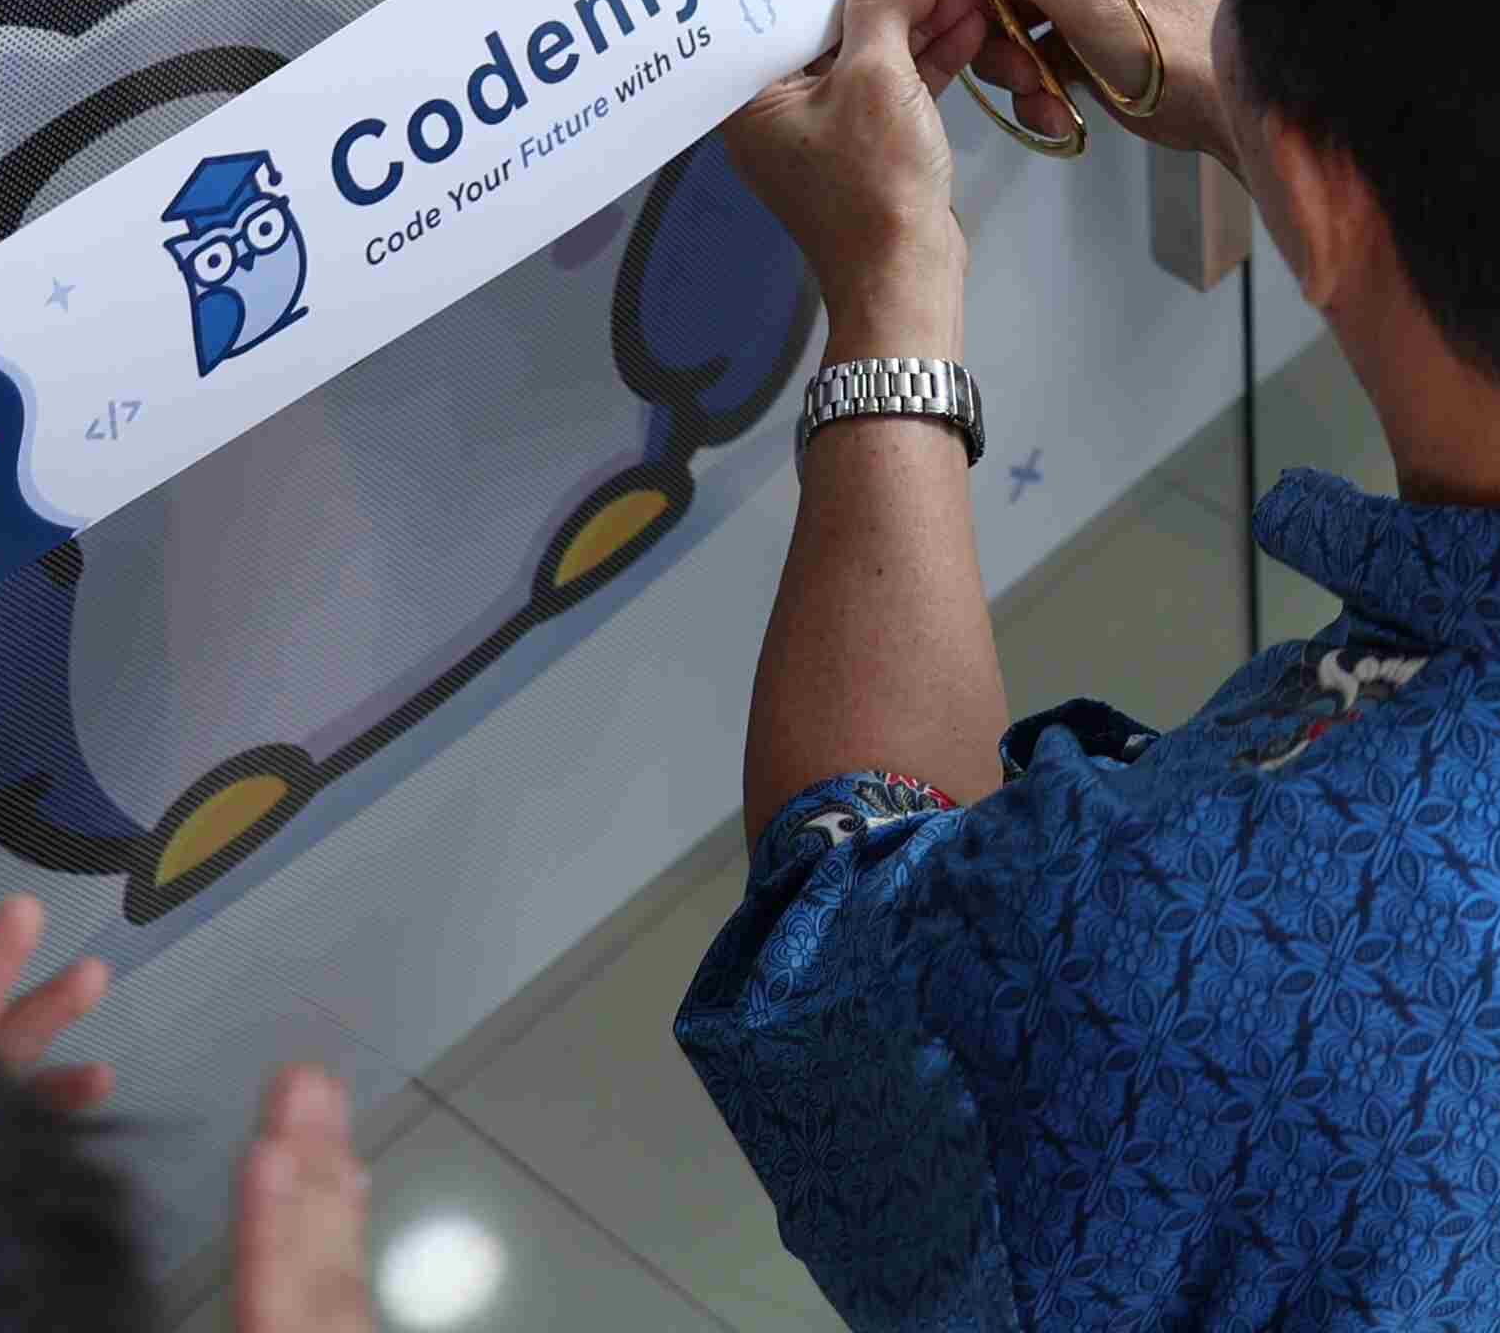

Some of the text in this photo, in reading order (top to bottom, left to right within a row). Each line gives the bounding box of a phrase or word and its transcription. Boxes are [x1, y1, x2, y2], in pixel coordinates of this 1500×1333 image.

[365, 24, 713, 266] Code Your Future with Us
